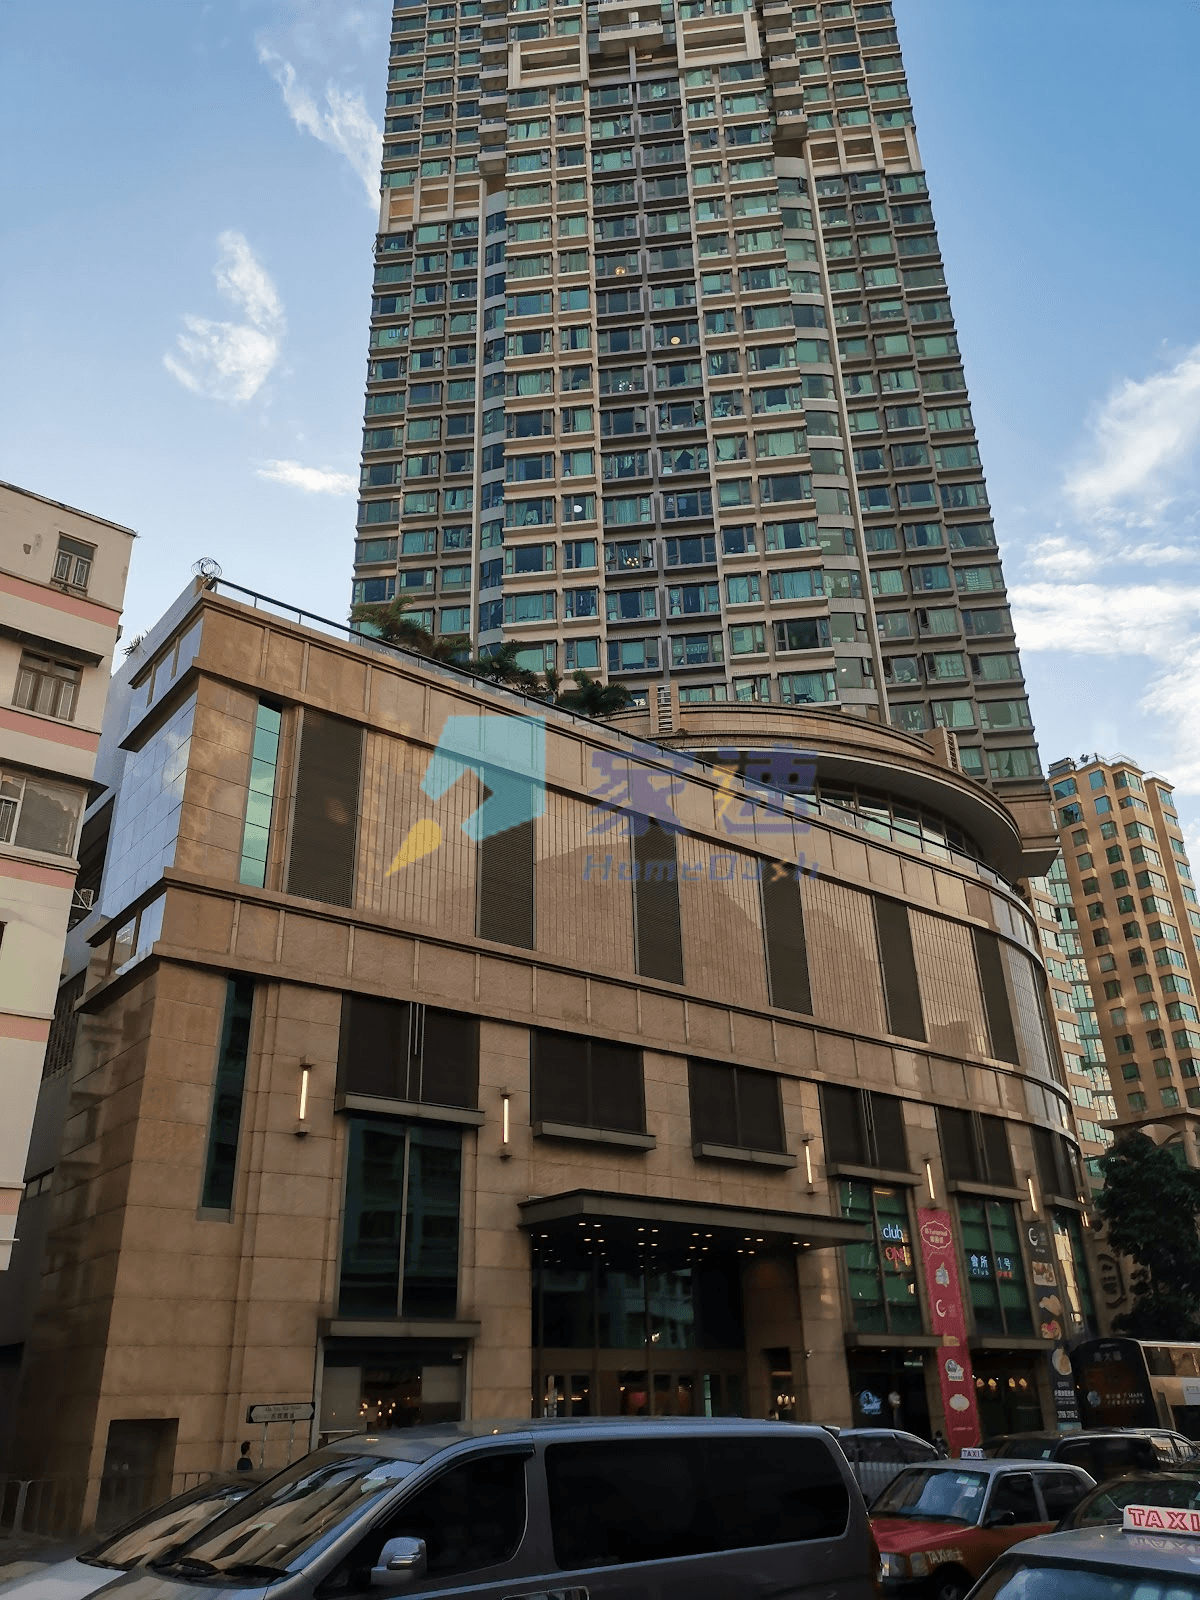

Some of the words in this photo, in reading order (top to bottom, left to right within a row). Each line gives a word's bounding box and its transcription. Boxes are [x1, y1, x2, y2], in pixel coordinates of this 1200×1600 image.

[882, 1223, 903, 1239] club
[962, 1449, 981, 1457] TAXI
[1127, 1507, 1200, 1532] TAXI
